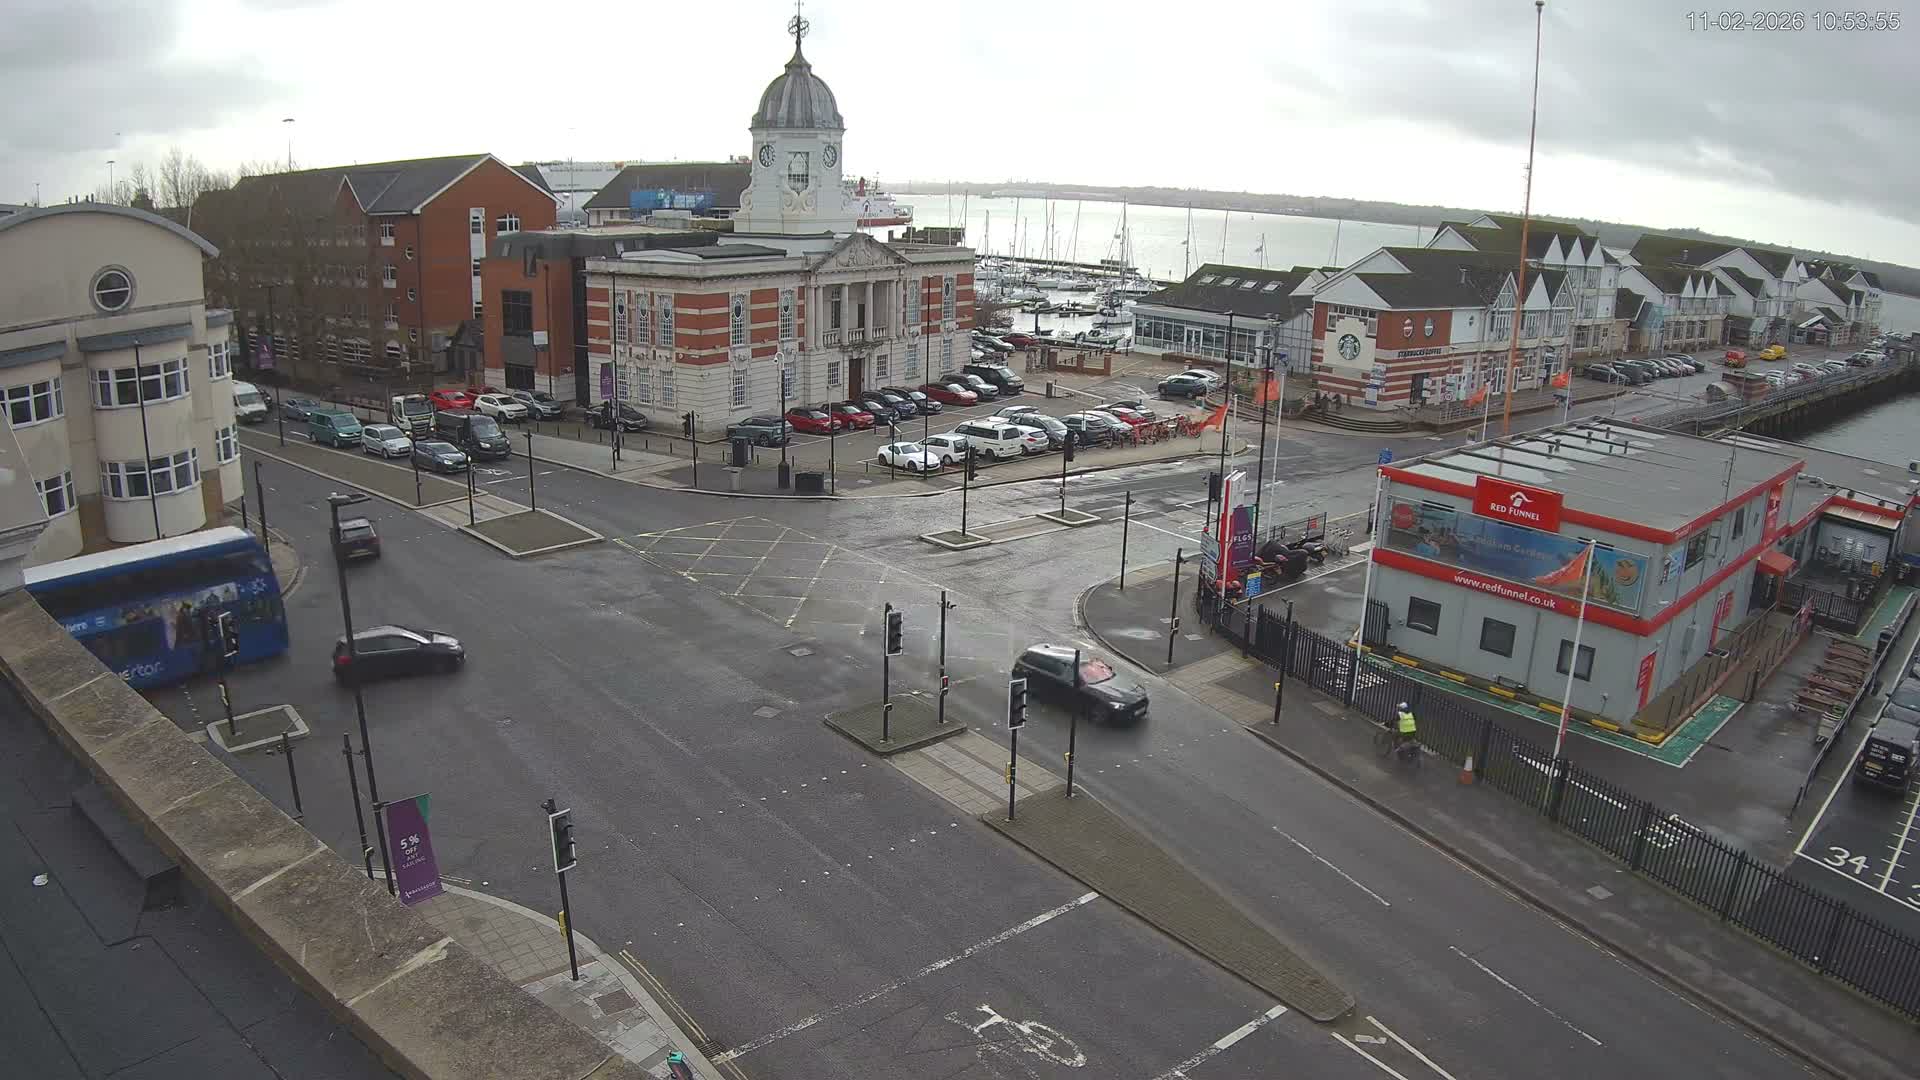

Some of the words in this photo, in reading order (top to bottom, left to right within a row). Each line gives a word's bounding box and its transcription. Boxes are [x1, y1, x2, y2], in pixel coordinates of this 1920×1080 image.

[1490, 502, 1507, 513] RED
[1508, 506, 1540, 521] FUNNEL
[1454, 575, 1556, 609] www.redfunnel.co.uk
[405, 846, 417, 855] OFF
[1823, 846, 1870, 875] 34
